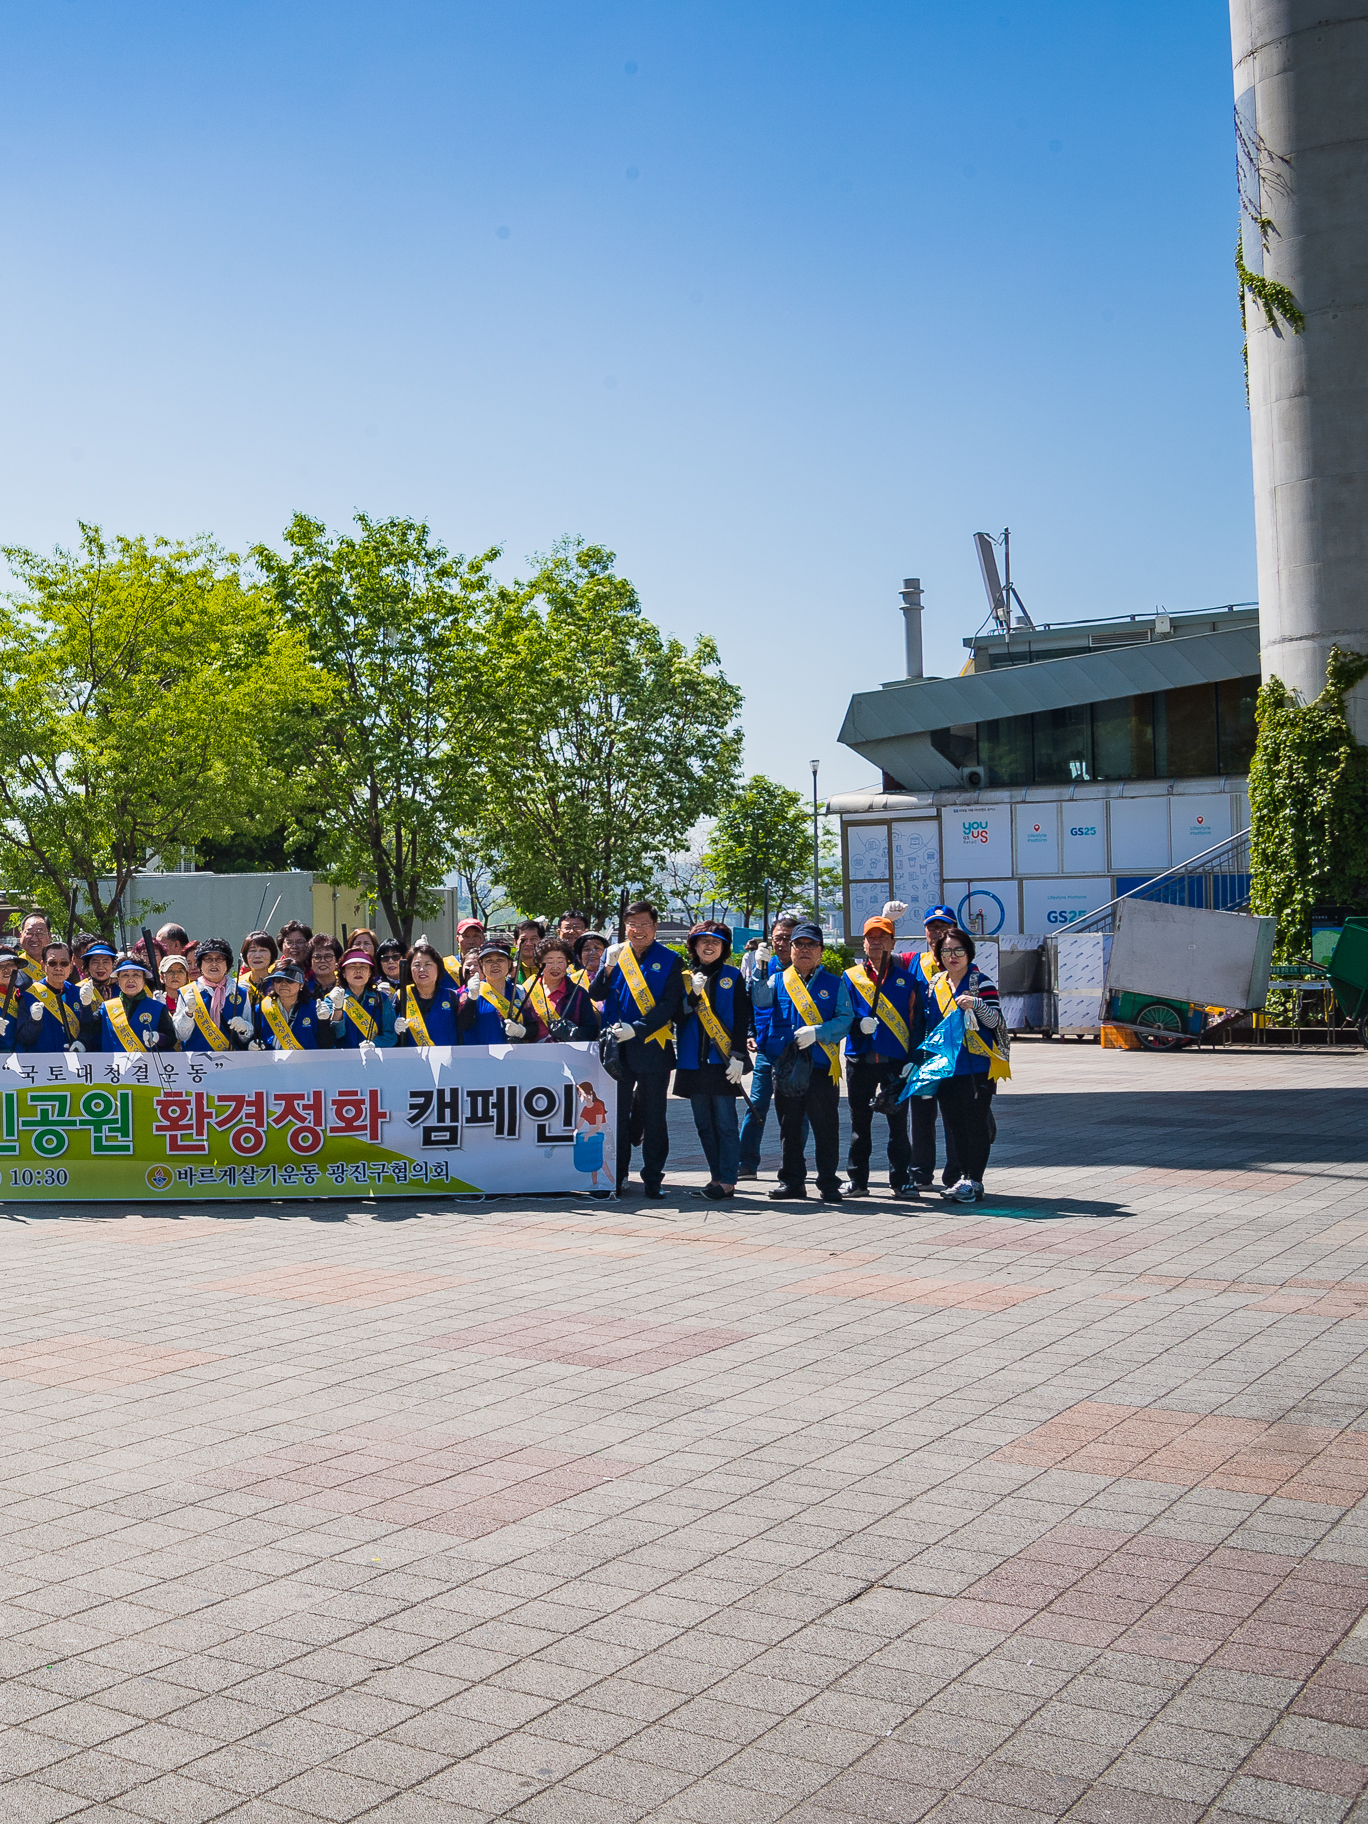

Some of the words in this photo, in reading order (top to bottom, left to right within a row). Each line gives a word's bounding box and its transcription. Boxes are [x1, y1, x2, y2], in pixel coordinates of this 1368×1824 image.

[1070, 827, 1096, 836] GS25
[114, 1022, 142, 1052] 바르게살기운
[153, 1086, 390, 1157] 환경정화
[405, 1084, 576, 1149] 캠페인
[10, 1167, 70, 1188] 10:30
[176, 1163, 322, 1188] 바르게살기운동
[326, 1160, 450, 1185] 광진구협의회
